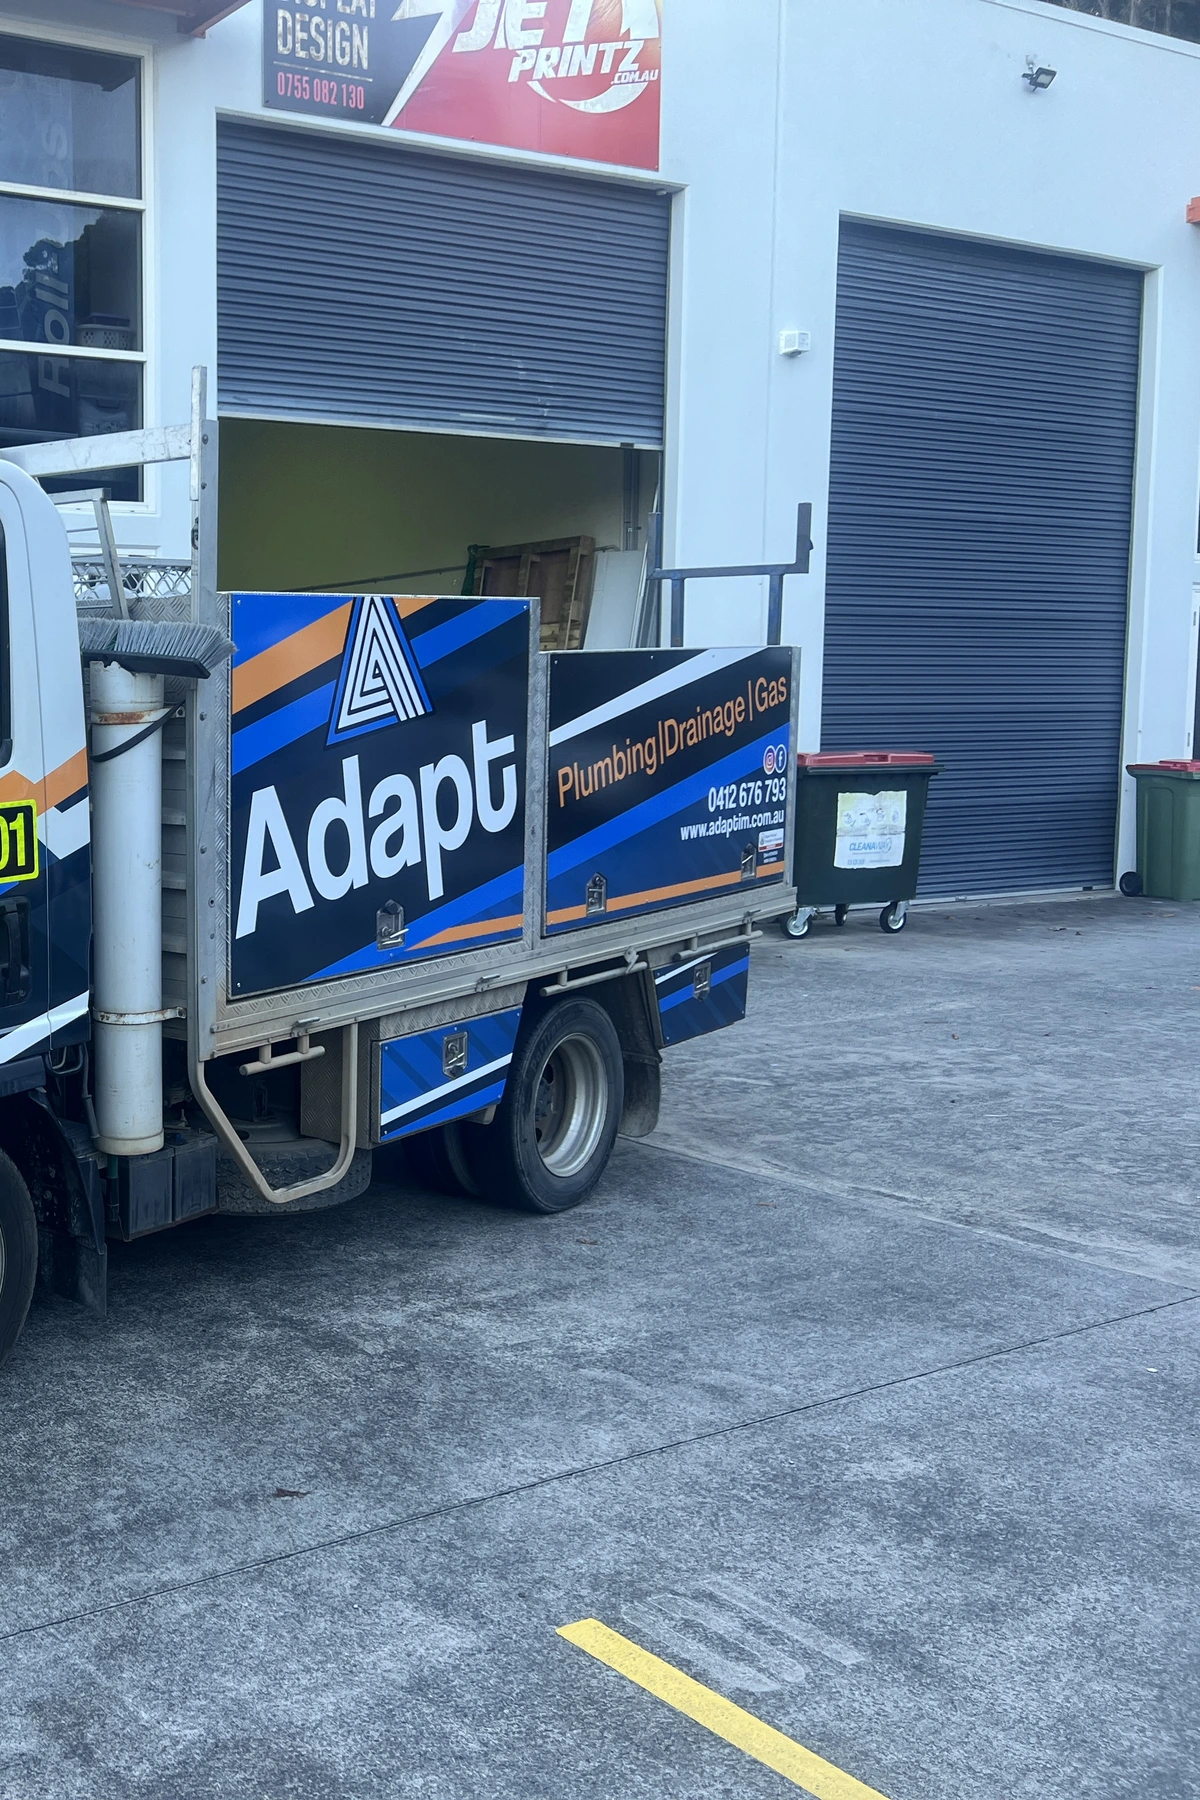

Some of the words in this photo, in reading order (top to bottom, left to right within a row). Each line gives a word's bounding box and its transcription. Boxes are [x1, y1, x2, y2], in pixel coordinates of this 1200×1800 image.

[276, 8, 369, 71] DESIGN
[507, 40, 645, 83] PRINTZ
[277, 71, 311, 100] 0755
[313, 78, 338, 106] 082
[341, 83, 366, 110] 130
[707, 784, 738, 813] 0412
[739, 780, 763, 807] 676
[763, 776, 786, 804] 793
[235, 719, 518, 940] Adapt
[680, 808, 785, 841] www.adaptim.com.au
